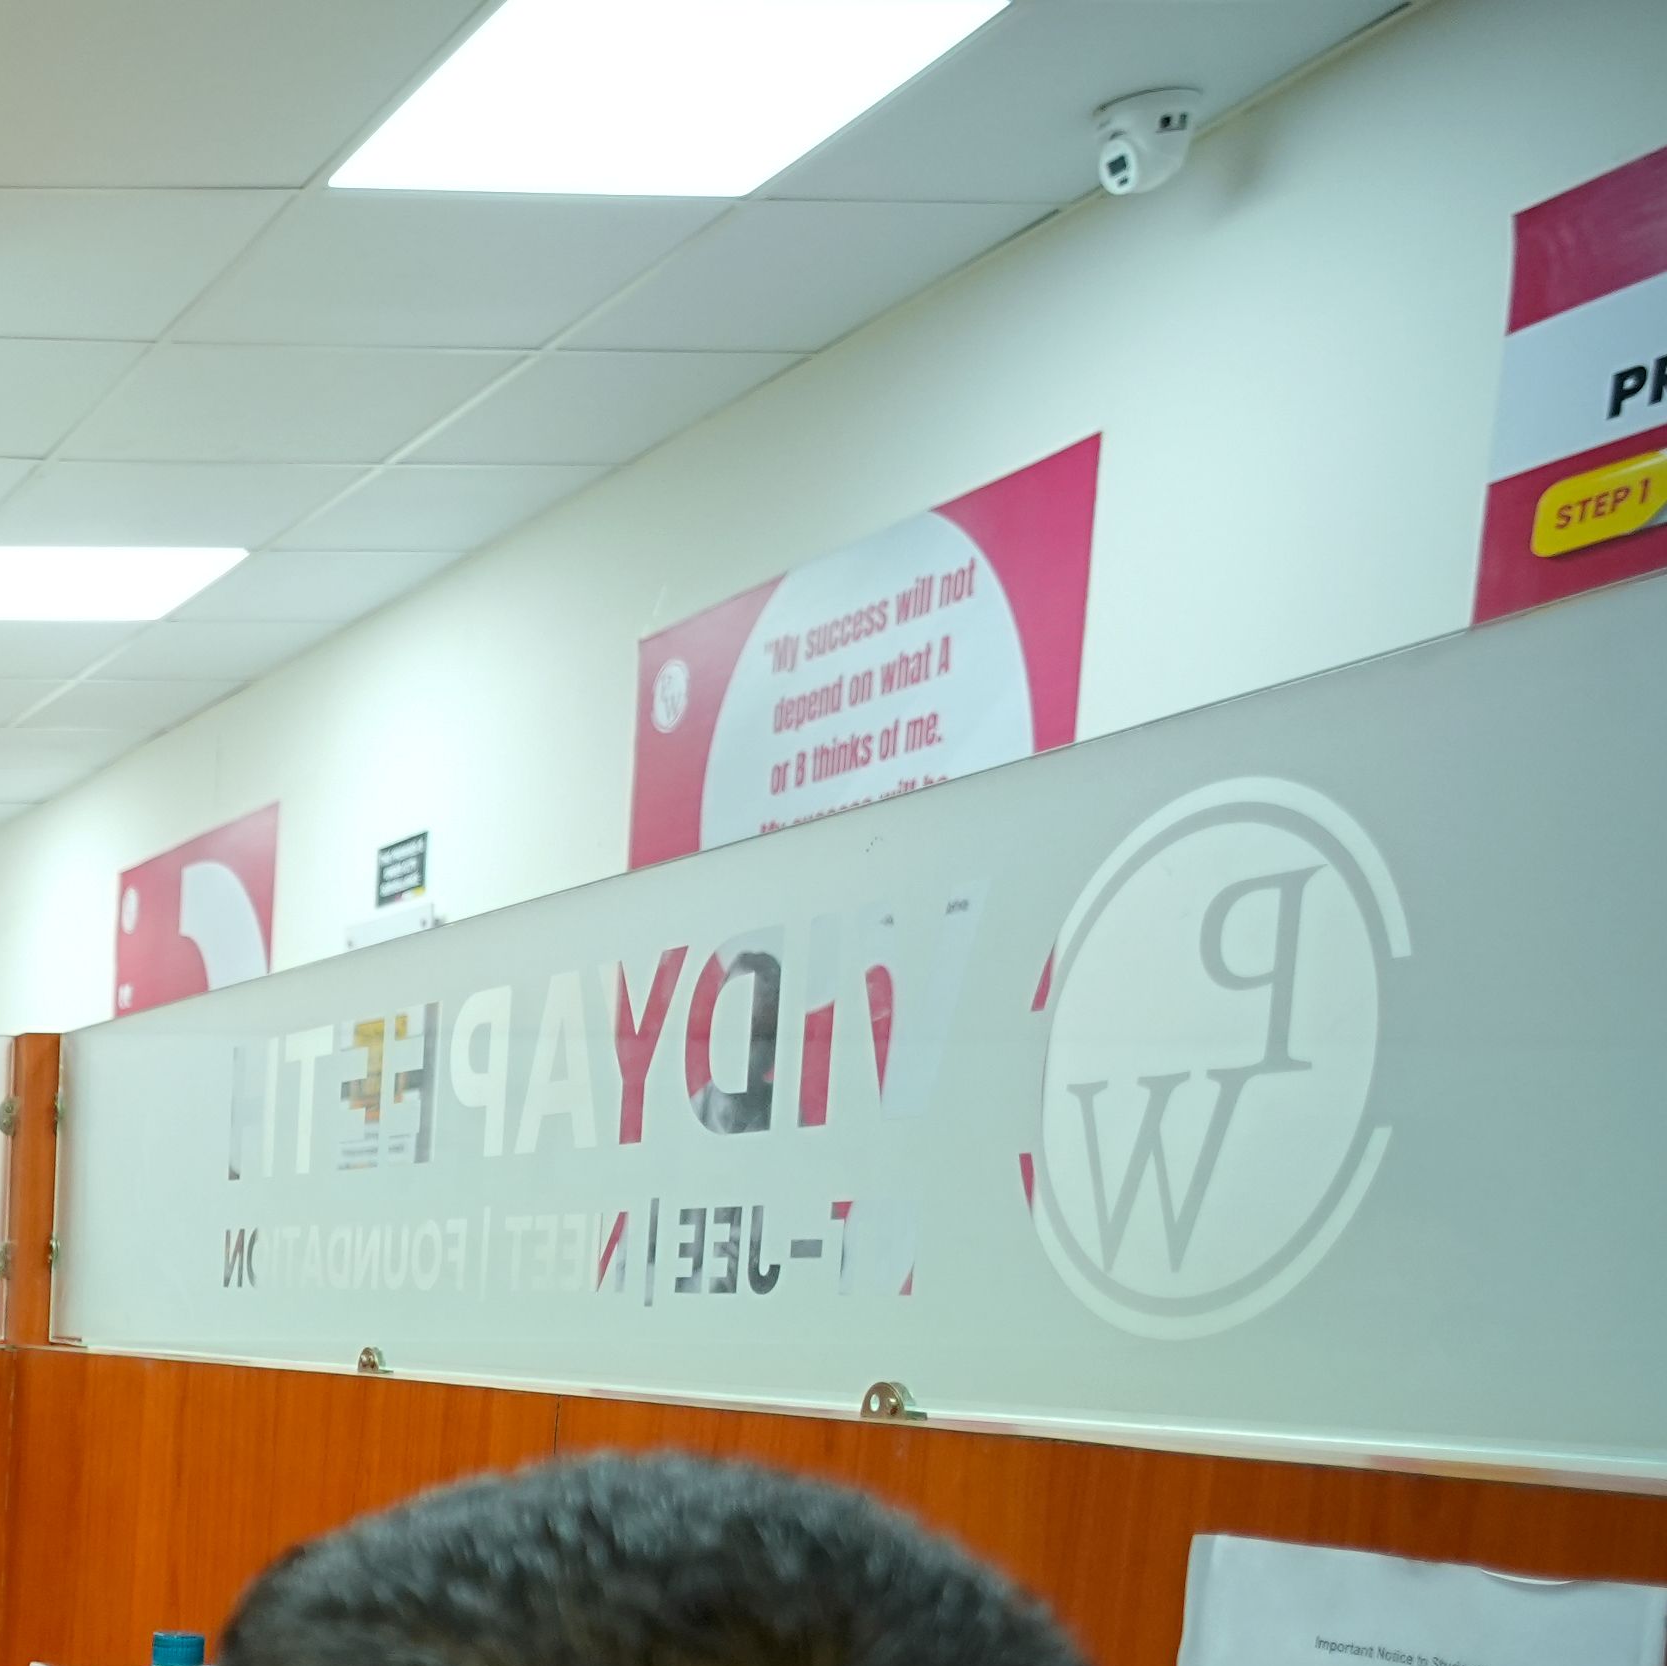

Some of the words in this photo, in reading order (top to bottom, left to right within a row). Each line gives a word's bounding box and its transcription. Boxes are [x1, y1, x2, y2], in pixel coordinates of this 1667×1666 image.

[1555, 487, 1632, 531] STEP
[1639, 478, 1653, 507] 1
[805, 599, 889, 661] success
[895, 572, 934, 626] will
[939, 556, 976, 607] not
[773, 674, 843, 734] depend
[848, 669, 874, 707] on
[880, 642, 932, 696] what
[938, 635, 952, 676] A
[770, 762, 790, 796] or
[795, 751, 807, 789] B
[812, 731, 874, 783] thinks
[879, 719, 899, 762] of
[904, 711, 943, 754] me.
[1315, 1636, 1374, 1659] Important
